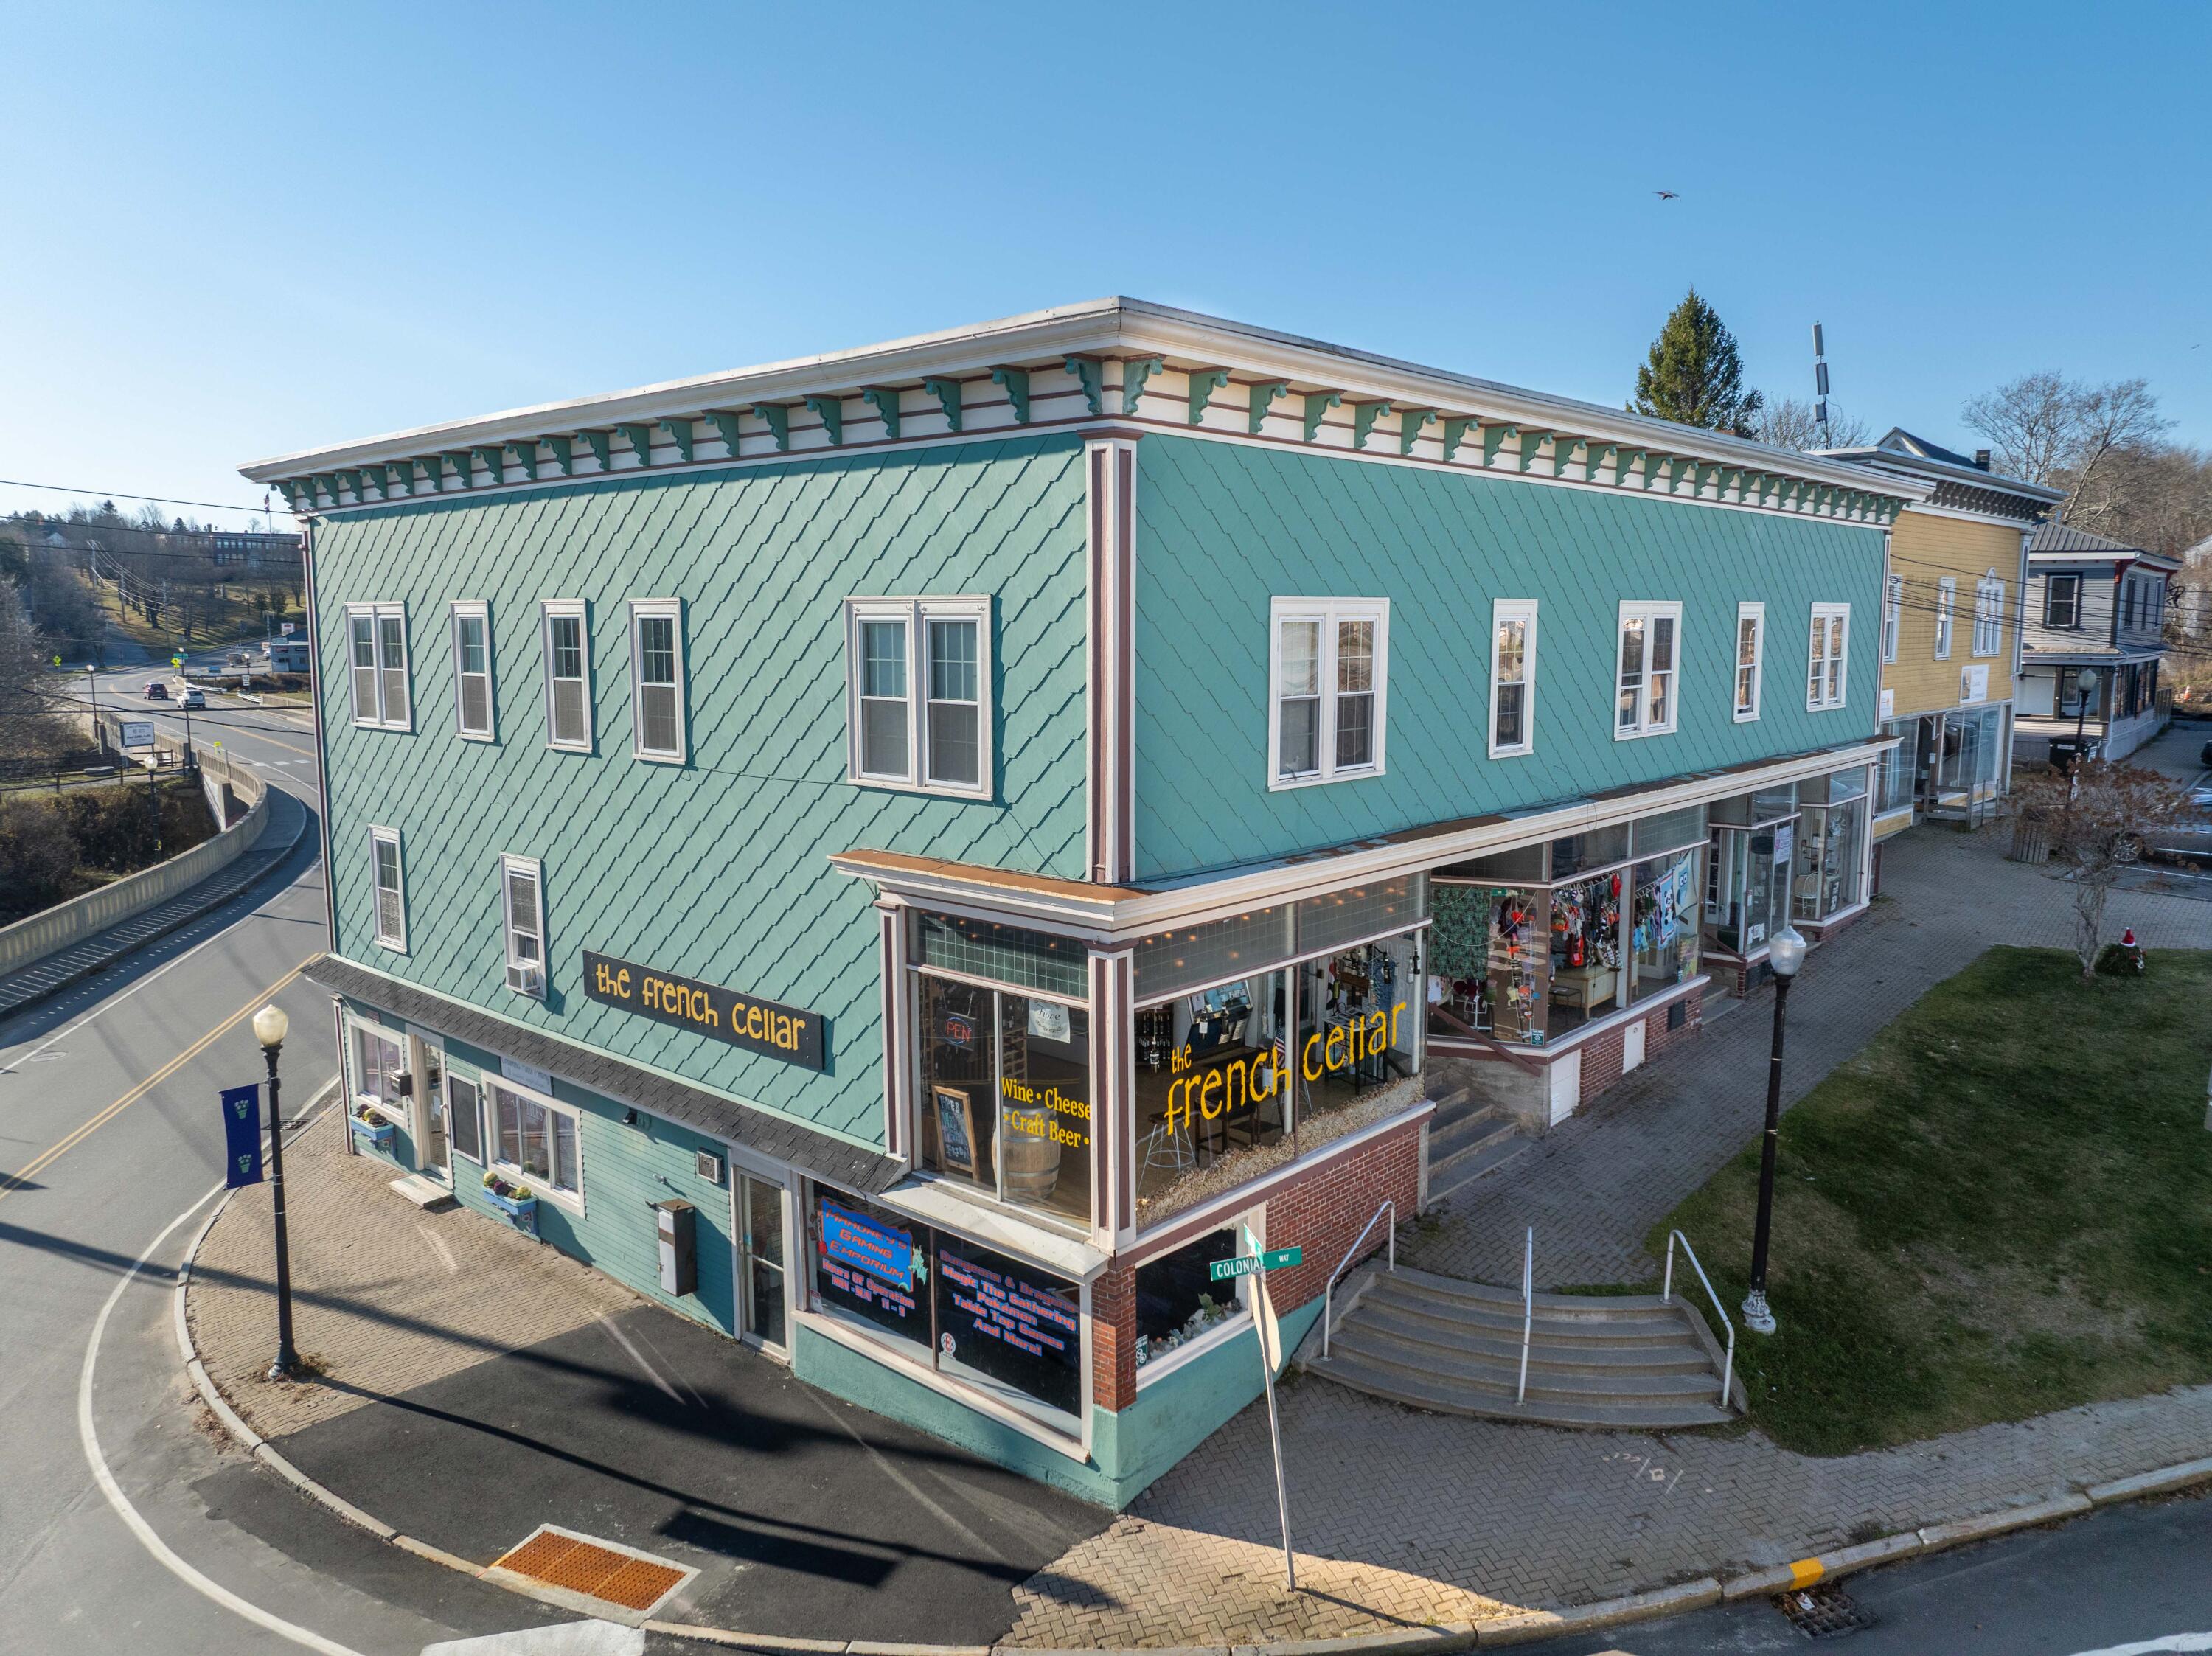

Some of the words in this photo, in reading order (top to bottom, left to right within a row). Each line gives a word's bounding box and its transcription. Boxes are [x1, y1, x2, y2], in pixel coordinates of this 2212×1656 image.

[596, 963, 631, 998] the
[642, 977, 719, 1027] french
[731, 1002, 806, 1051] cellar
[1164, 1046, 1290, 1135] french
[1302, 1001, 1407, 1082] cellar
[1172, 1043, 1192, 1074] the
[1001, 1076, 1034, 1104] Wine
[1045, 1087, 1091, 1120] Cheese
[1012, 1110, 1045, 1137] Craft
[1048, 1120, 1081, 1148] Beer
[1005, 1276, 1016, 1290] &
[1217, 1256, 1266, 1278] COLONIAL
[1279, 1253, 1289, 1263] WAY
[866, 1278, 915, 1309] Operation
[942, 1264, 978, 1290] Magic
[981, 1280, 1006, 1300] The
[1009, 1292, 1077, 1332] Gathering
[953, 1293, 987, 1318] Table
[990, 1309, 1015, 1330] Top
[1018, 1321, 1065, 1351] Games
[973, 1318, 1001, 1338] And
